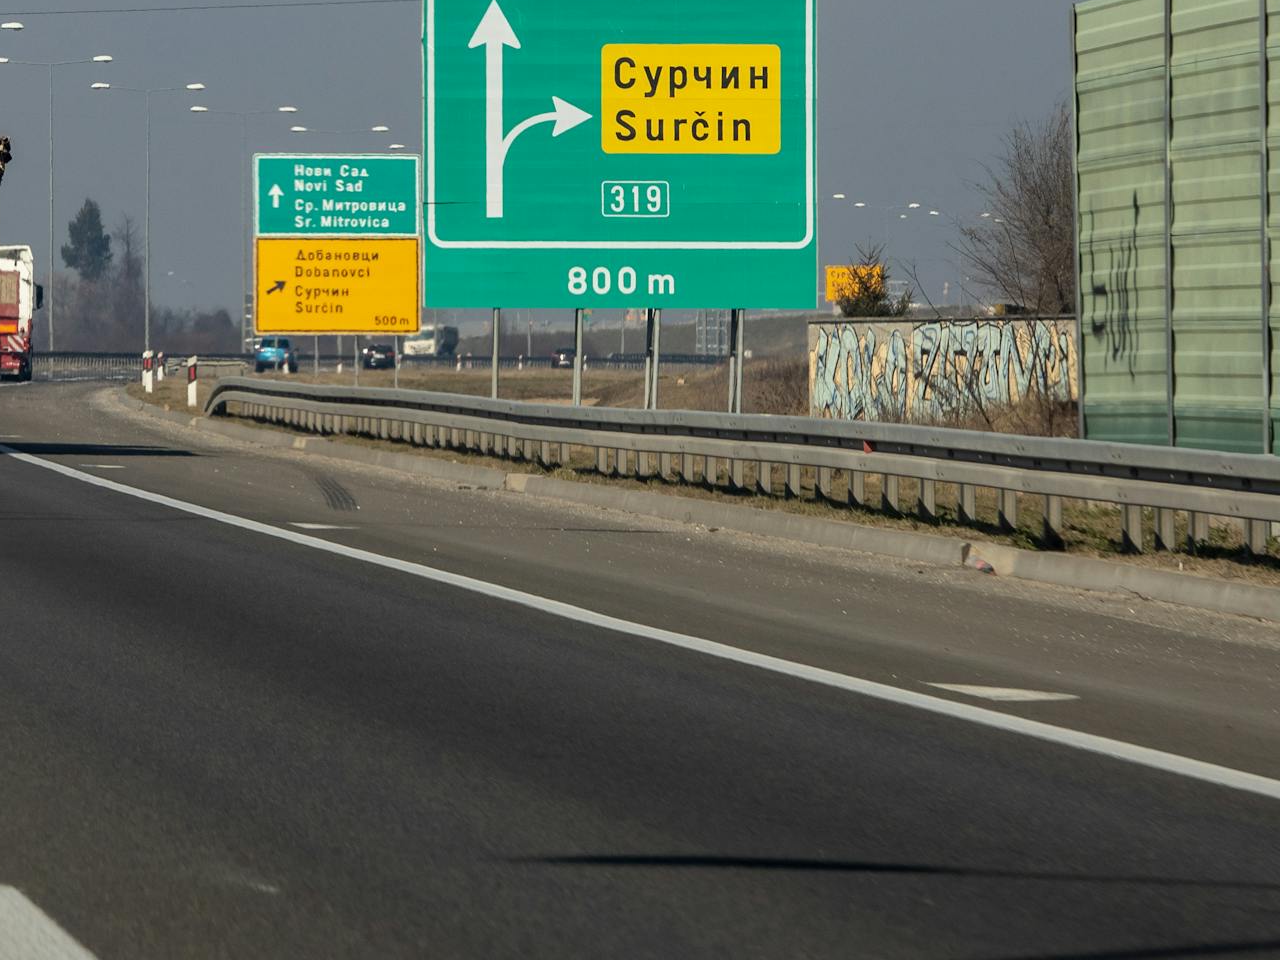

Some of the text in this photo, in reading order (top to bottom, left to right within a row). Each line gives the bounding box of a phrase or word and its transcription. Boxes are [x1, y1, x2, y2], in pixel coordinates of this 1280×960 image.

[614, 56, 769, 98] Сурчин
[615, 109, 752, 142] Surčin
[294, 164, 369, 177] Нови Сад
[294, 179, 363, 192] Novi Sad
[294, 198, 406, 214] Ср. Митровица
[609, 185, 662, 213] 319
[294, 215, 390, 228] Sr. Mitrovica
[296, 249, 380, 262] Добановци
[295, 266, 371, 278] Dobanovci
[567, 266, 676, 295] 800 m
[295, 285, 350, 300] Сурчин
[374, 315, 410, 326] 500 m
